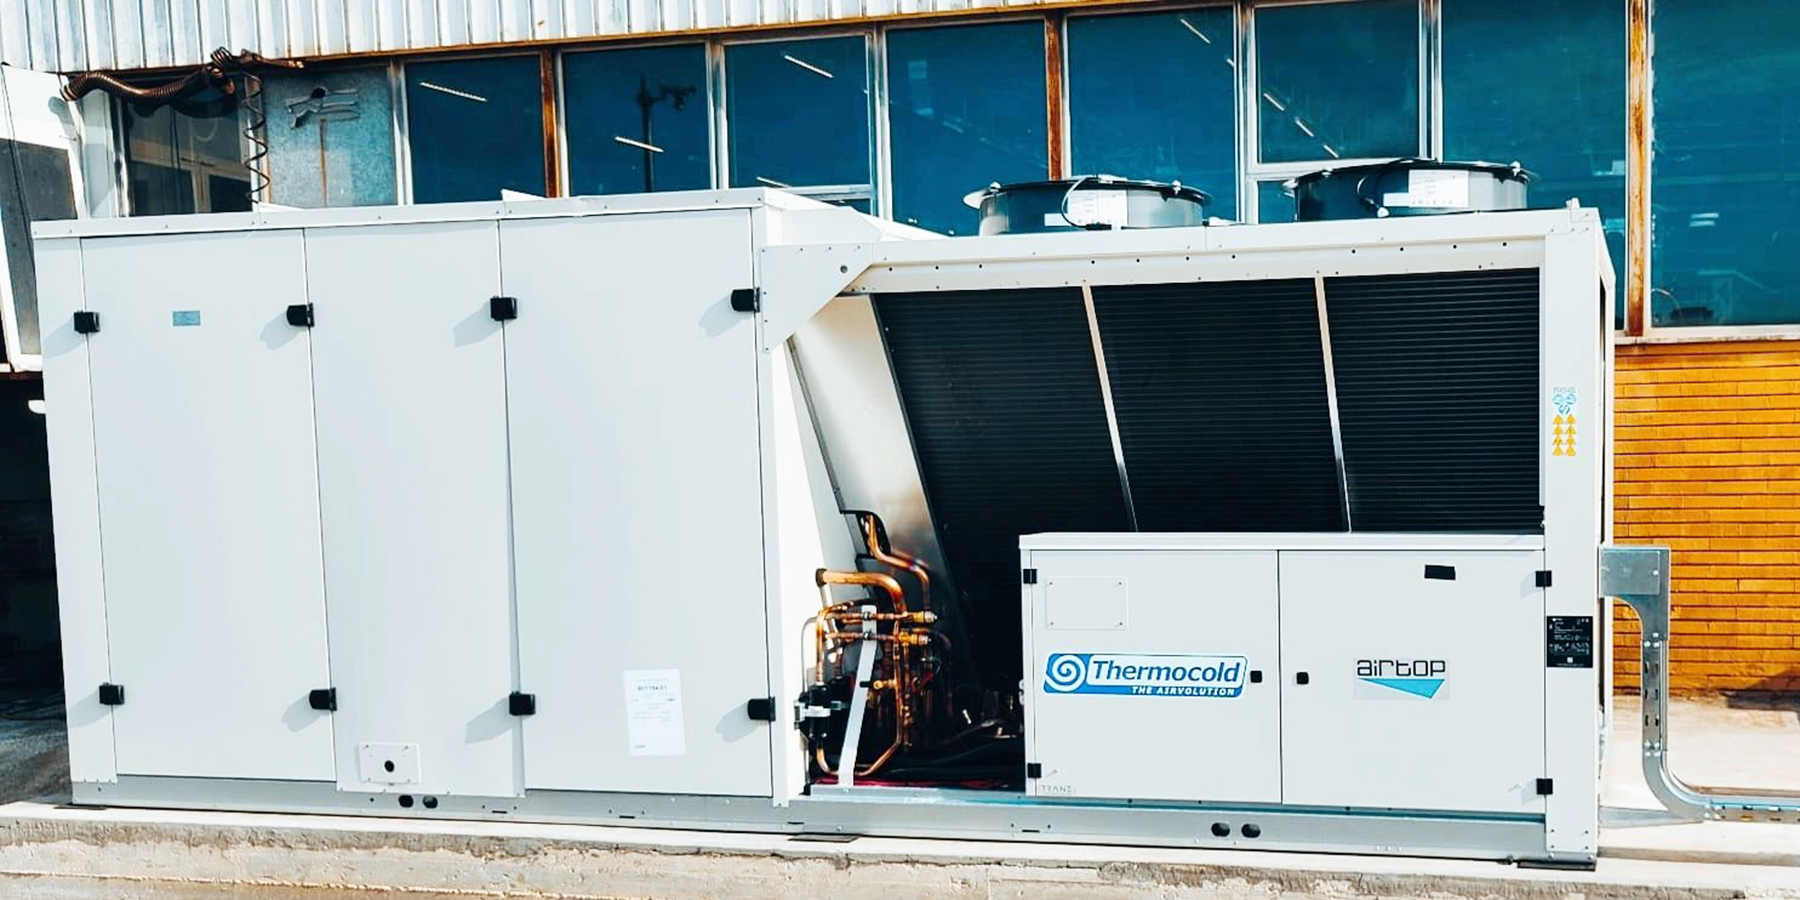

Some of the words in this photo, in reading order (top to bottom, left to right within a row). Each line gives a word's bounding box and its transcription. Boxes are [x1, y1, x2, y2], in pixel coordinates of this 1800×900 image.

[1093, 660, 1241, 682] Thermocold
[1357, 659, 1445, 677] airtop
[1132, 686, 1151, 694] THE
[1156, 686, 1235, 696] AIRVOLUTION
